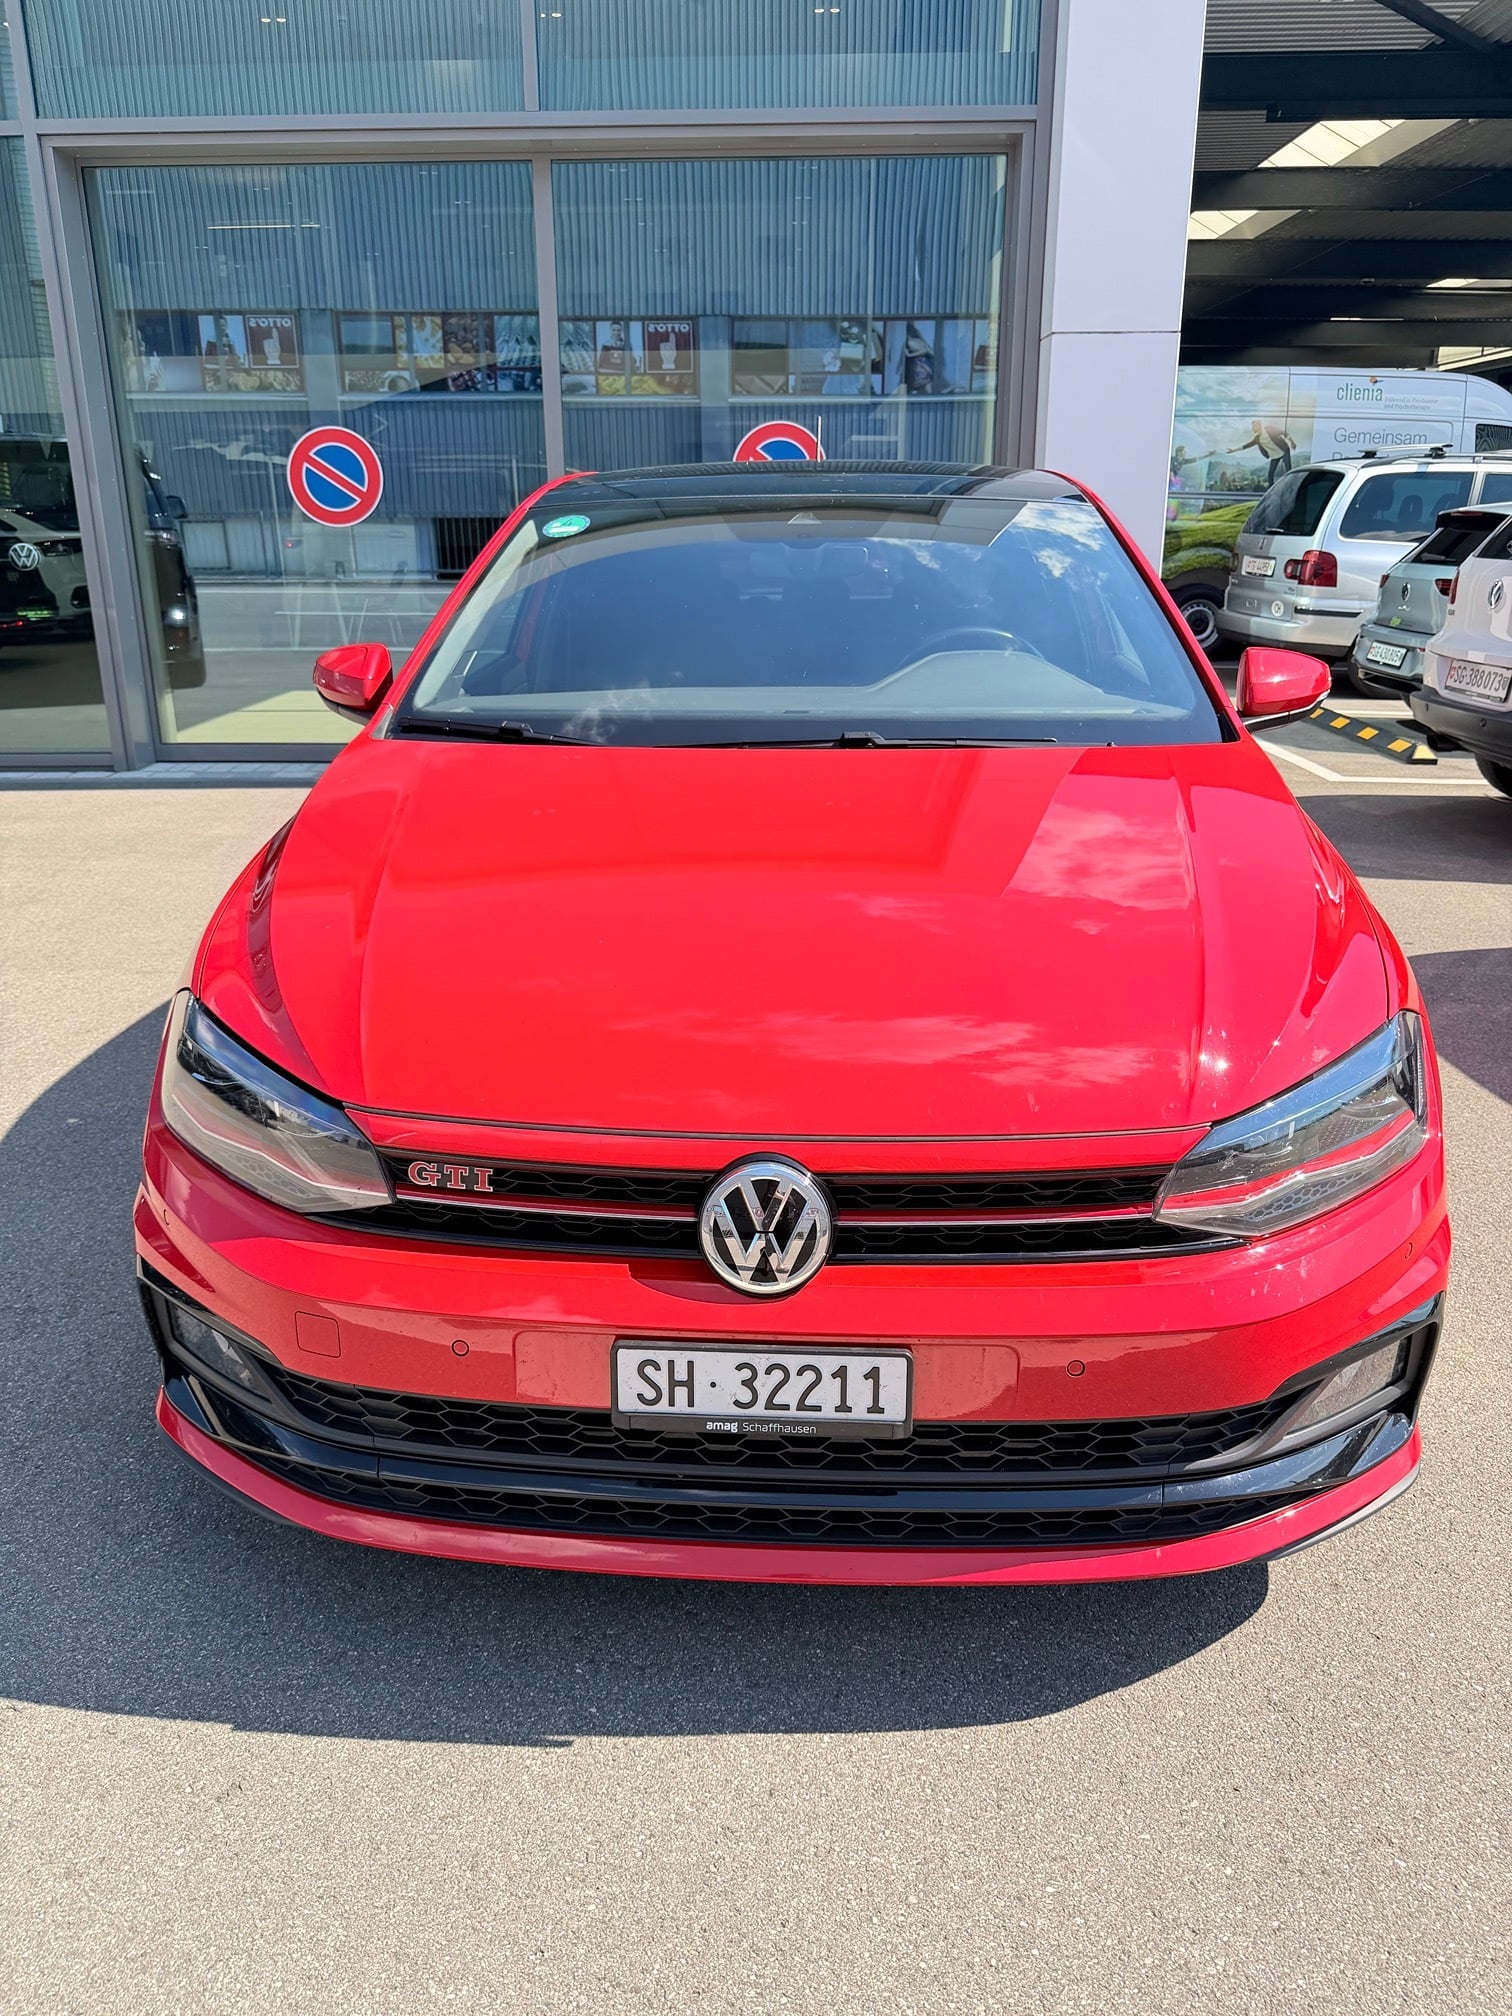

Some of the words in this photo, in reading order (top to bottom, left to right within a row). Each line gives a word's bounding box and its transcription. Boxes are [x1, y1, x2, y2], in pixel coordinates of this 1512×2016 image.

[1337, 383, 1383, 401] clienia
[1334, 427, 1427, 445] Gemeinsam
[408, 1161, 493, 1192] GTI
[706, 1420, 738, 1434] amag
[743, 1421, 817, 1434] Schaffhausen
